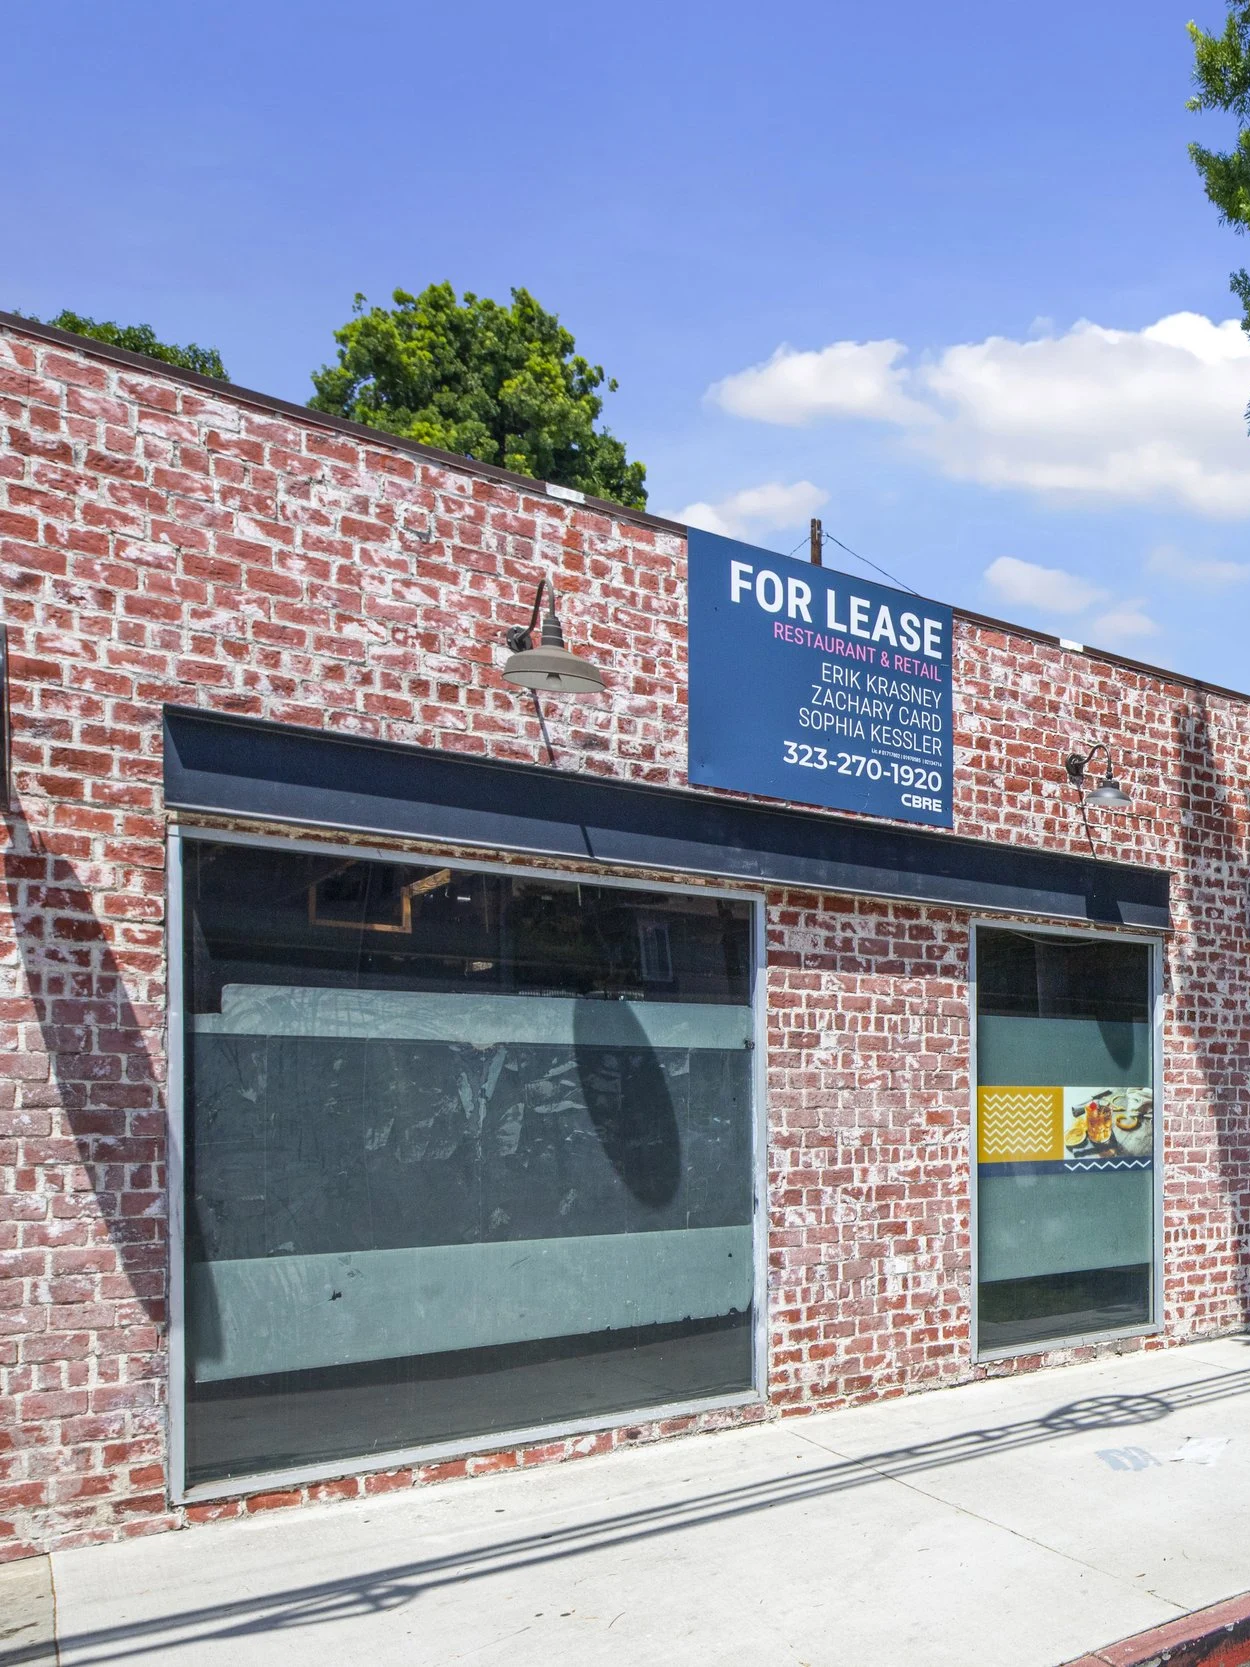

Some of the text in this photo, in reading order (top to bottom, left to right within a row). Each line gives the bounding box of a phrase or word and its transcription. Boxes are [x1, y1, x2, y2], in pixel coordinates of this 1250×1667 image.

[730, 560, 943, 660] FOR LEASE
[773, 621, 943, 682] RESTAURANT & RETAIL
[811, 685, 943, 732] ZACHARY CARD
[822, 662, 943, 709] ERIK KRASNEY
[798, 707, 943, 756] SOPHIA KESSLER
[783, 740, 943, 792] 323-270-1920
[901, 793, 943, 813] CBRE
